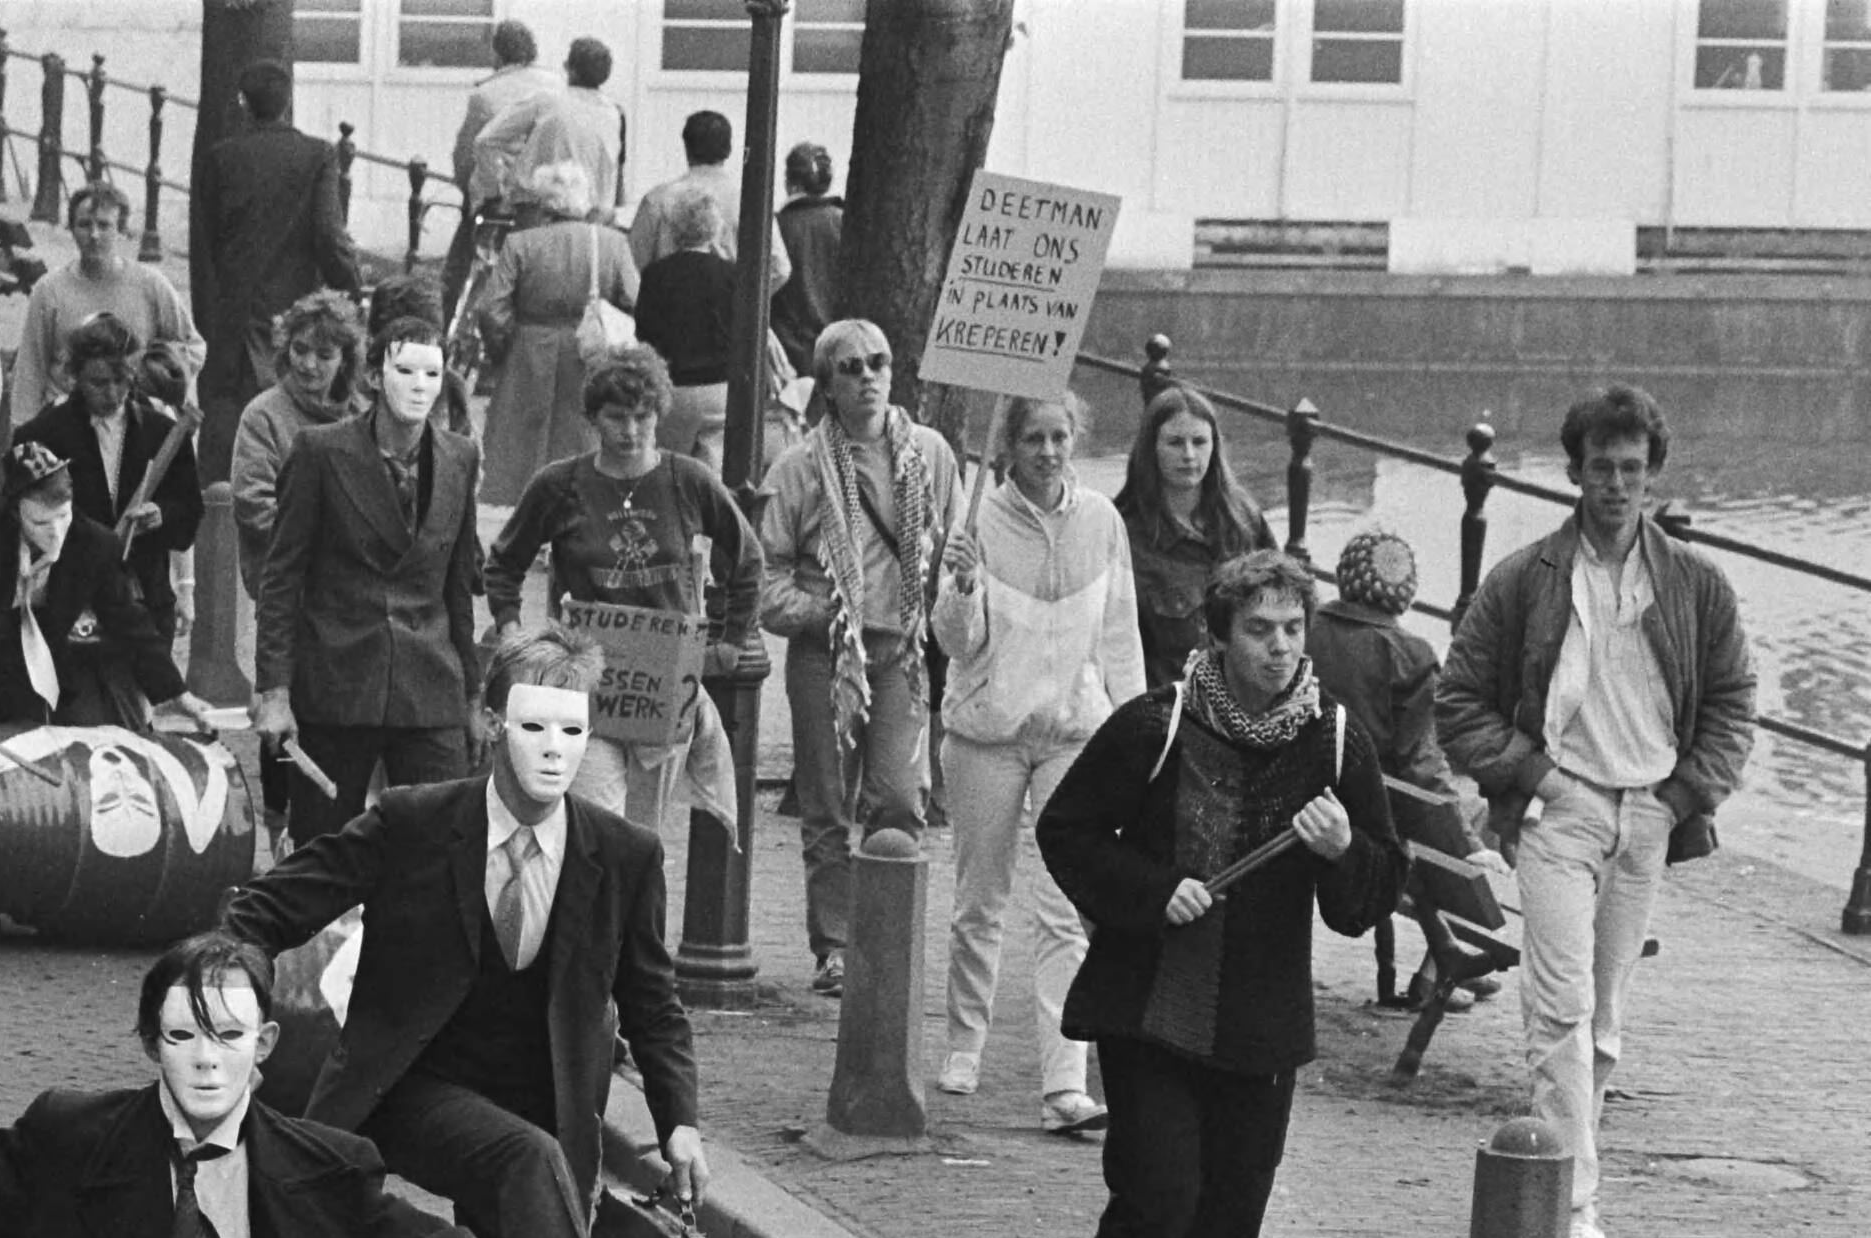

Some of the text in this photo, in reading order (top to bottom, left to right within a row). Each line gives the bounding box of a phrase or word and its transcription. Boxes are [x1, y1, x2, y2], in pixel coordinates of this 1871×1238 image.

[980, 188, 1103, 231] DEETMAN
[963, 223, 1080, 264] LAAT ONS
[961, 254, 1063, 285] STUDEREN
[973, 290, 1039, 314] PLAATS
[1047, 301, 1078, 319] VAN
[567, 608, 688, 636] STUDEREN
[595, 694, 666, 719] WERK
